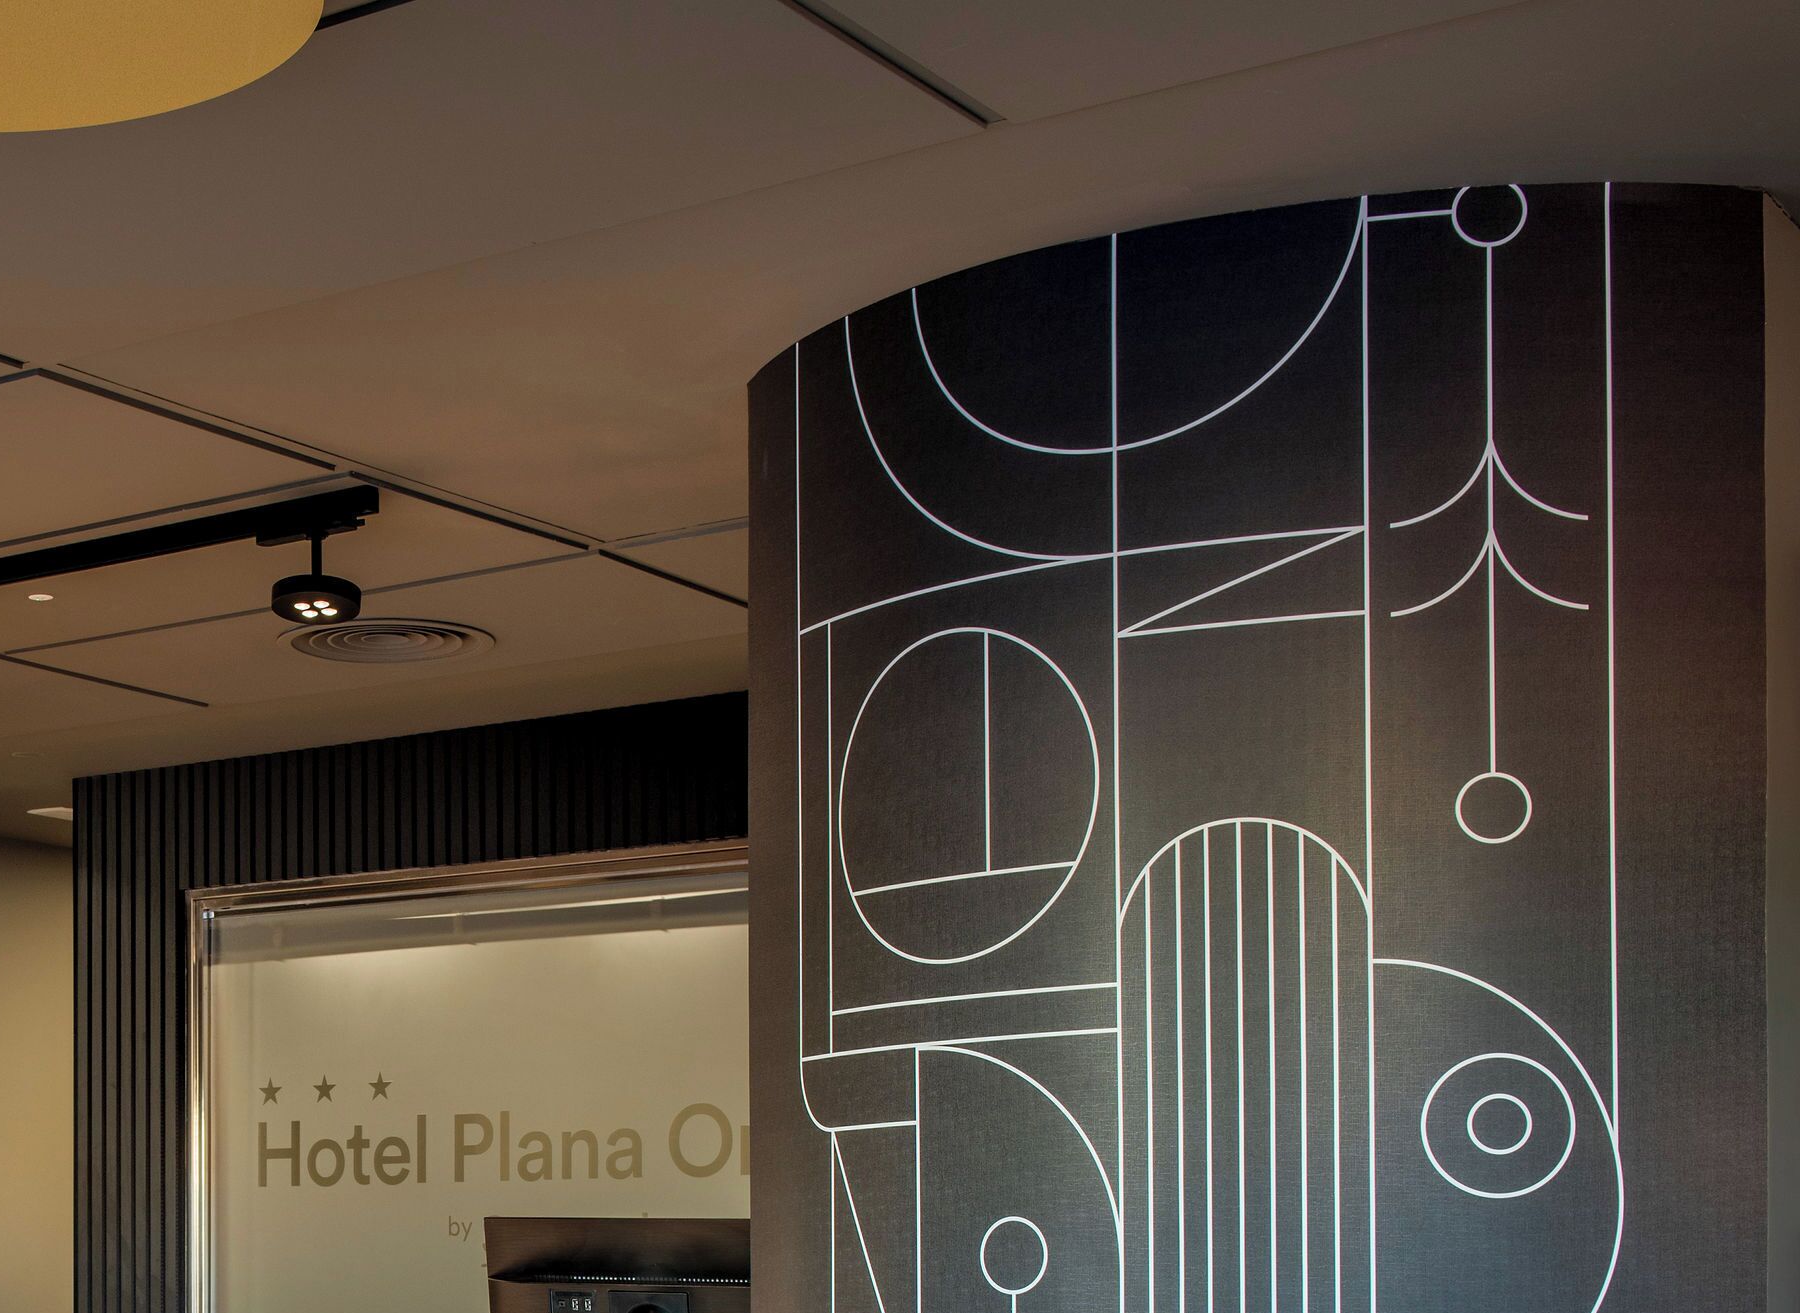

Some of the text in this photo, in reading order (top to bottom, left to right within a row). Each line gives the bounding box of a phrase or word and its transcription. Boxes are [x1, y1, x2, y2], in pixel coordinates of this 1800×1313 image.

[257, 1103, 750, 1188] Hotel Plana O
[448, 1215, 473, 1240] by
